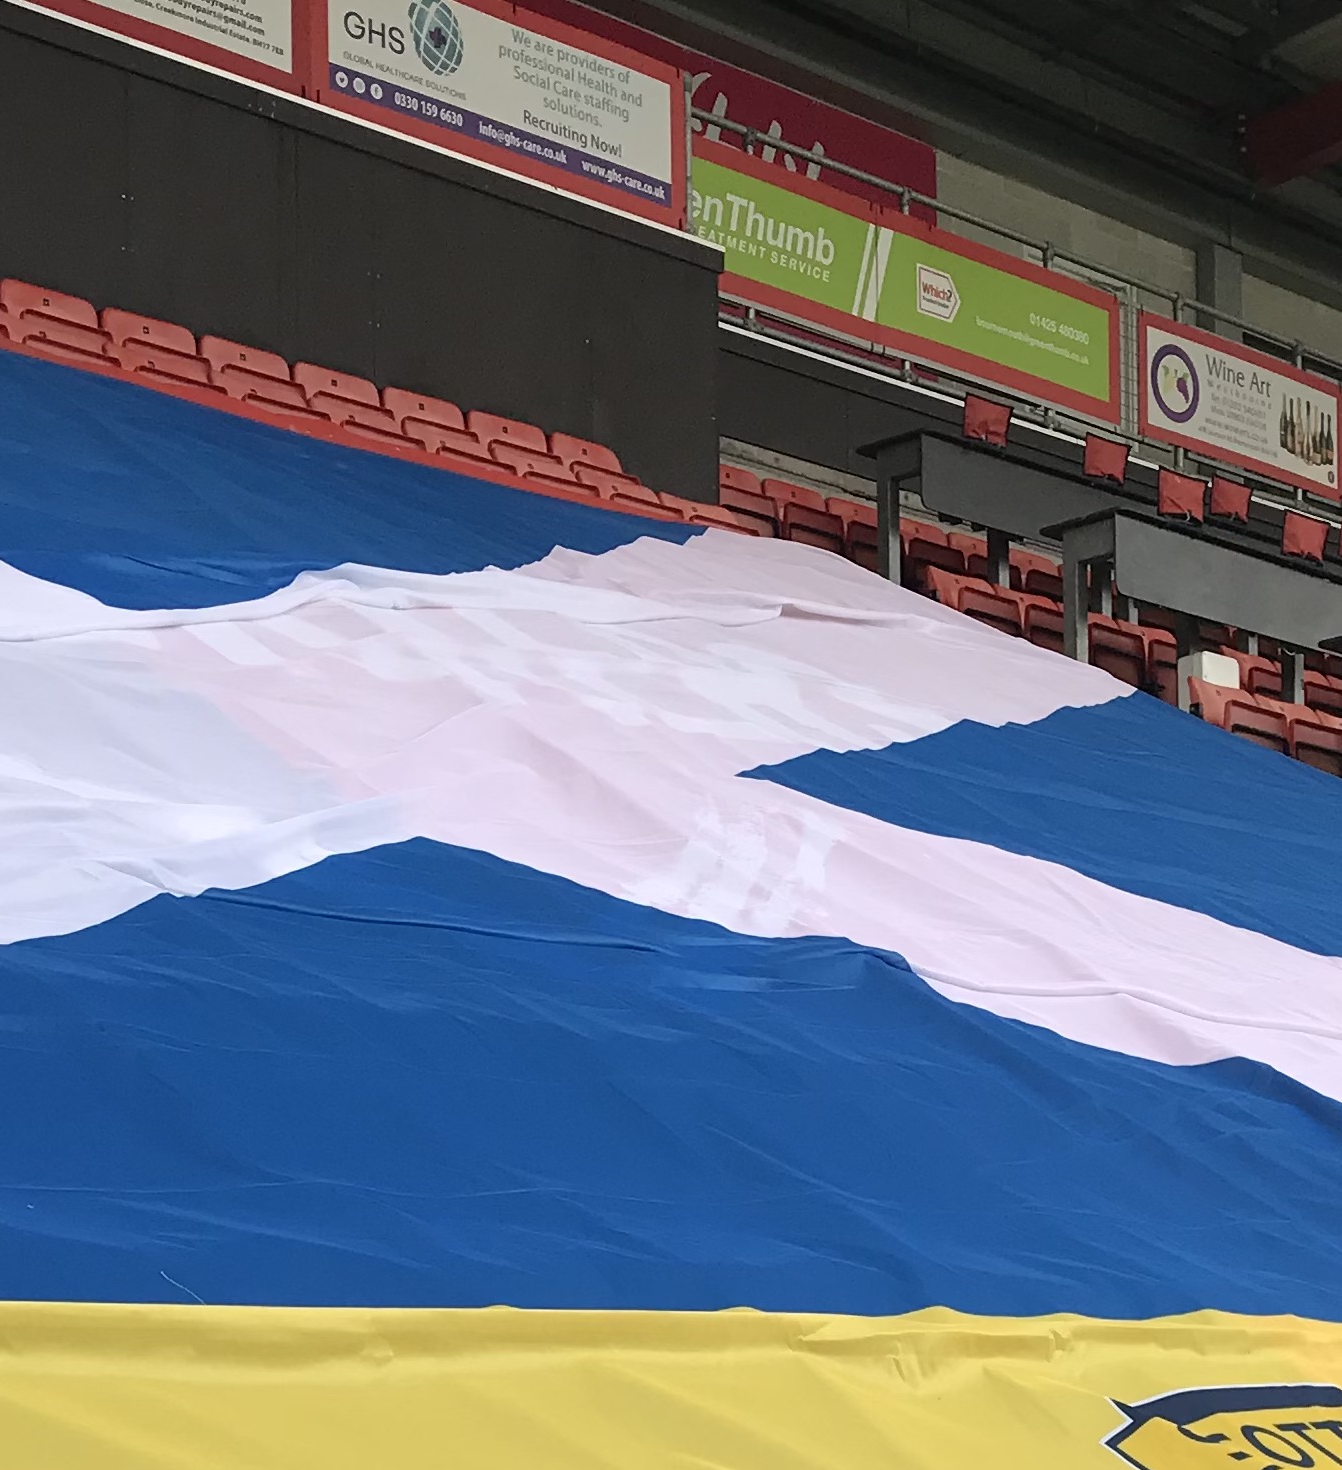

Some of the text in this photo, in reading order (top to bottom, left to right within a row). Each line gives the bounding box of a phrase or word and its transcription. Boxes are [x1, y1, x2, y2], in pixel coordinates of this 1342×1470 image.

[168, 0, 265, 36] dyrepairs@gmail.com
[344, 11, 405, 55] GHS
[343, 51, 467, 101] GLOBAL HEALTHCARE SOLUTIONS
[498, 45, 643, 108] professional Health and
[512, 28, 631, 85] We are providers of
[513, 65, 629, 123] Social Care staffing
[543, 96, 603, 127] solutions.
[394, 91, 419, 112] 0330
[421, 99, 439, 118] 159
[440, 107, 463, 127] 6630
[581, 160, 666, 200] www.ghs-care.co.uk
[523, 109, 623, 158] Recruiting Now!
[694, 224, 831, 283] EATMENT SERVICE
[922, 282, 953, 303] Which?
[1206, 354, 1272, 398] Wine Art
